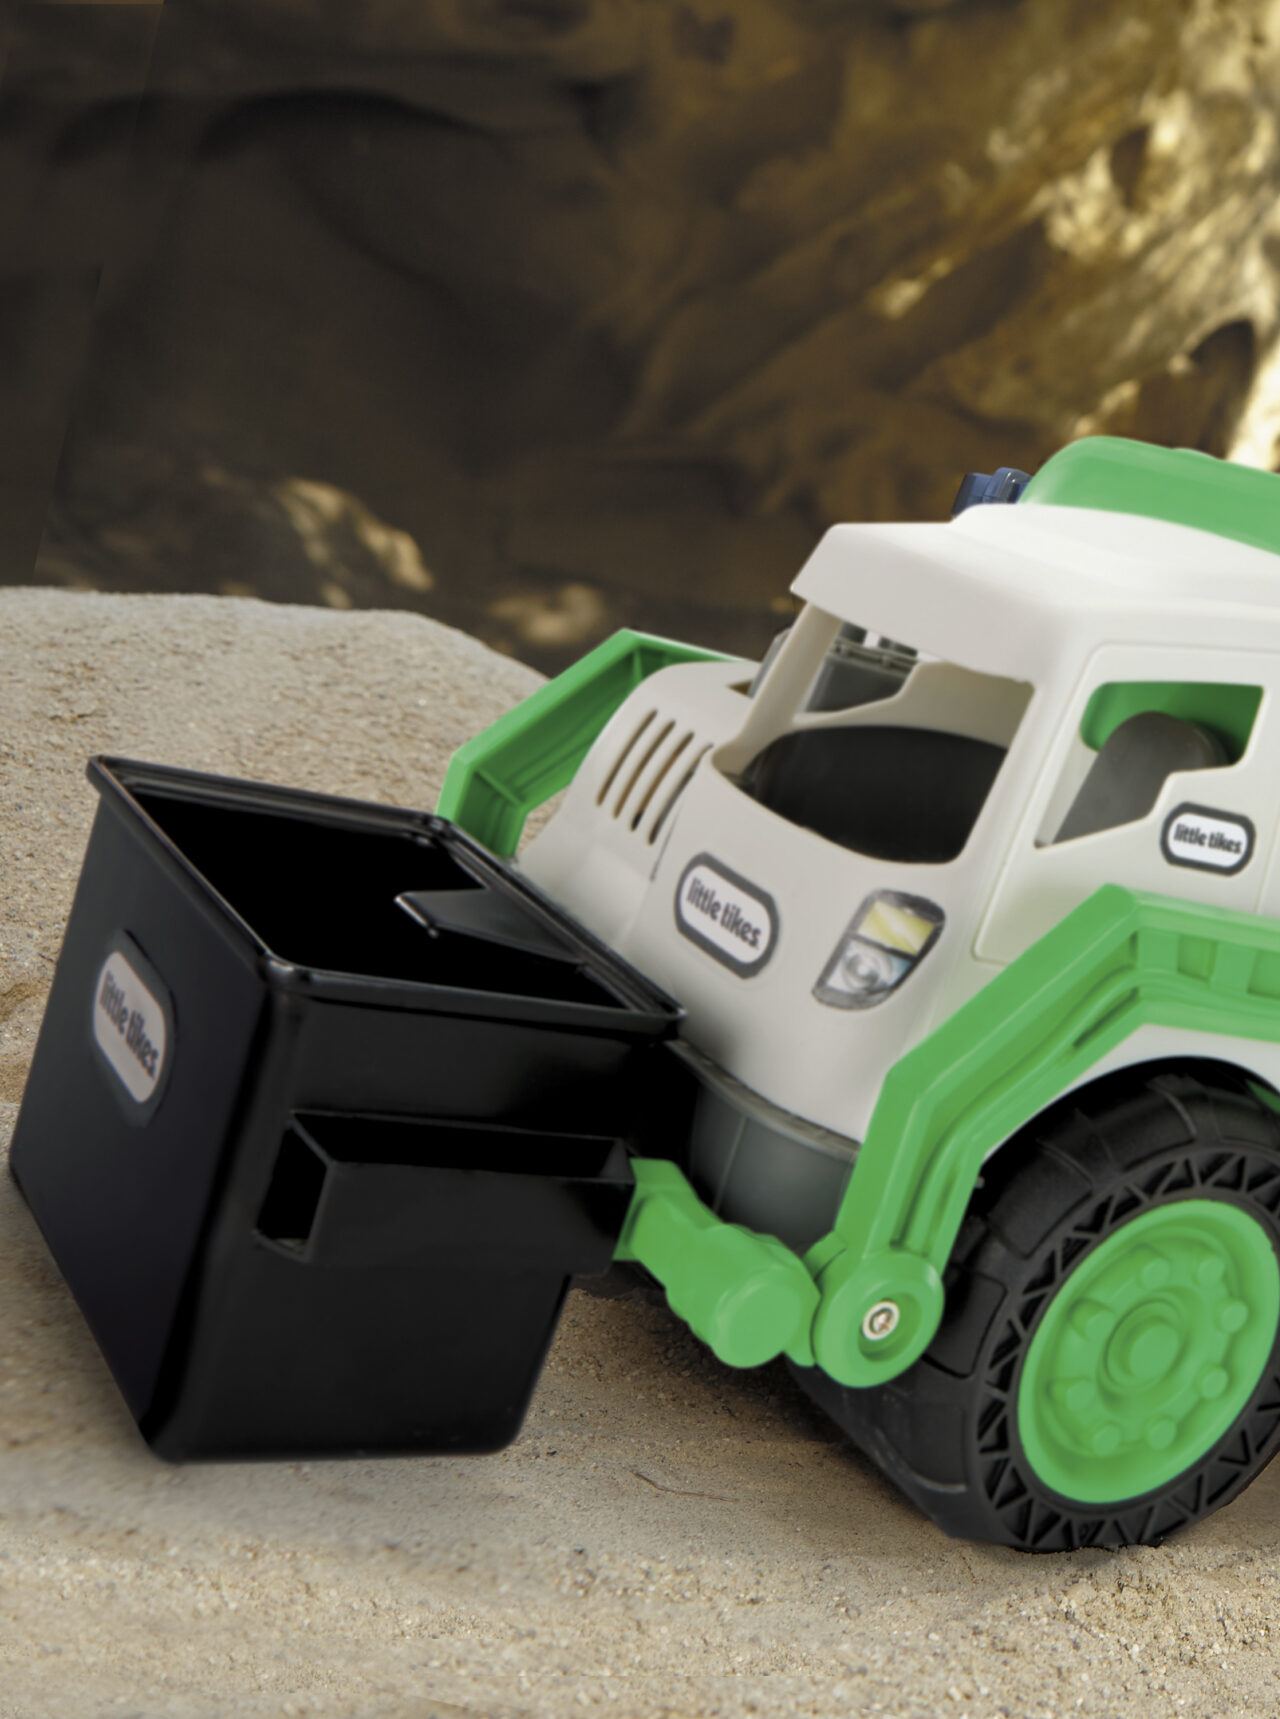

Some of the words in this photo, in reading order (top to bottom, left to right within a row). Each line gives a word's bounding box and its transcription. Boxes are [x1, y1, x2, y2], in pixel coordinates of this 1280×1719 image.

[1174, 823, 1207, 847] little
[1208, 832, 1242, 854] tikes
[686, 876, 721, 921] little
[720, 902, 760, 949] tikes
[99, 969, 129, 1035] little
[126, 1009, 158, 1080] tikes
